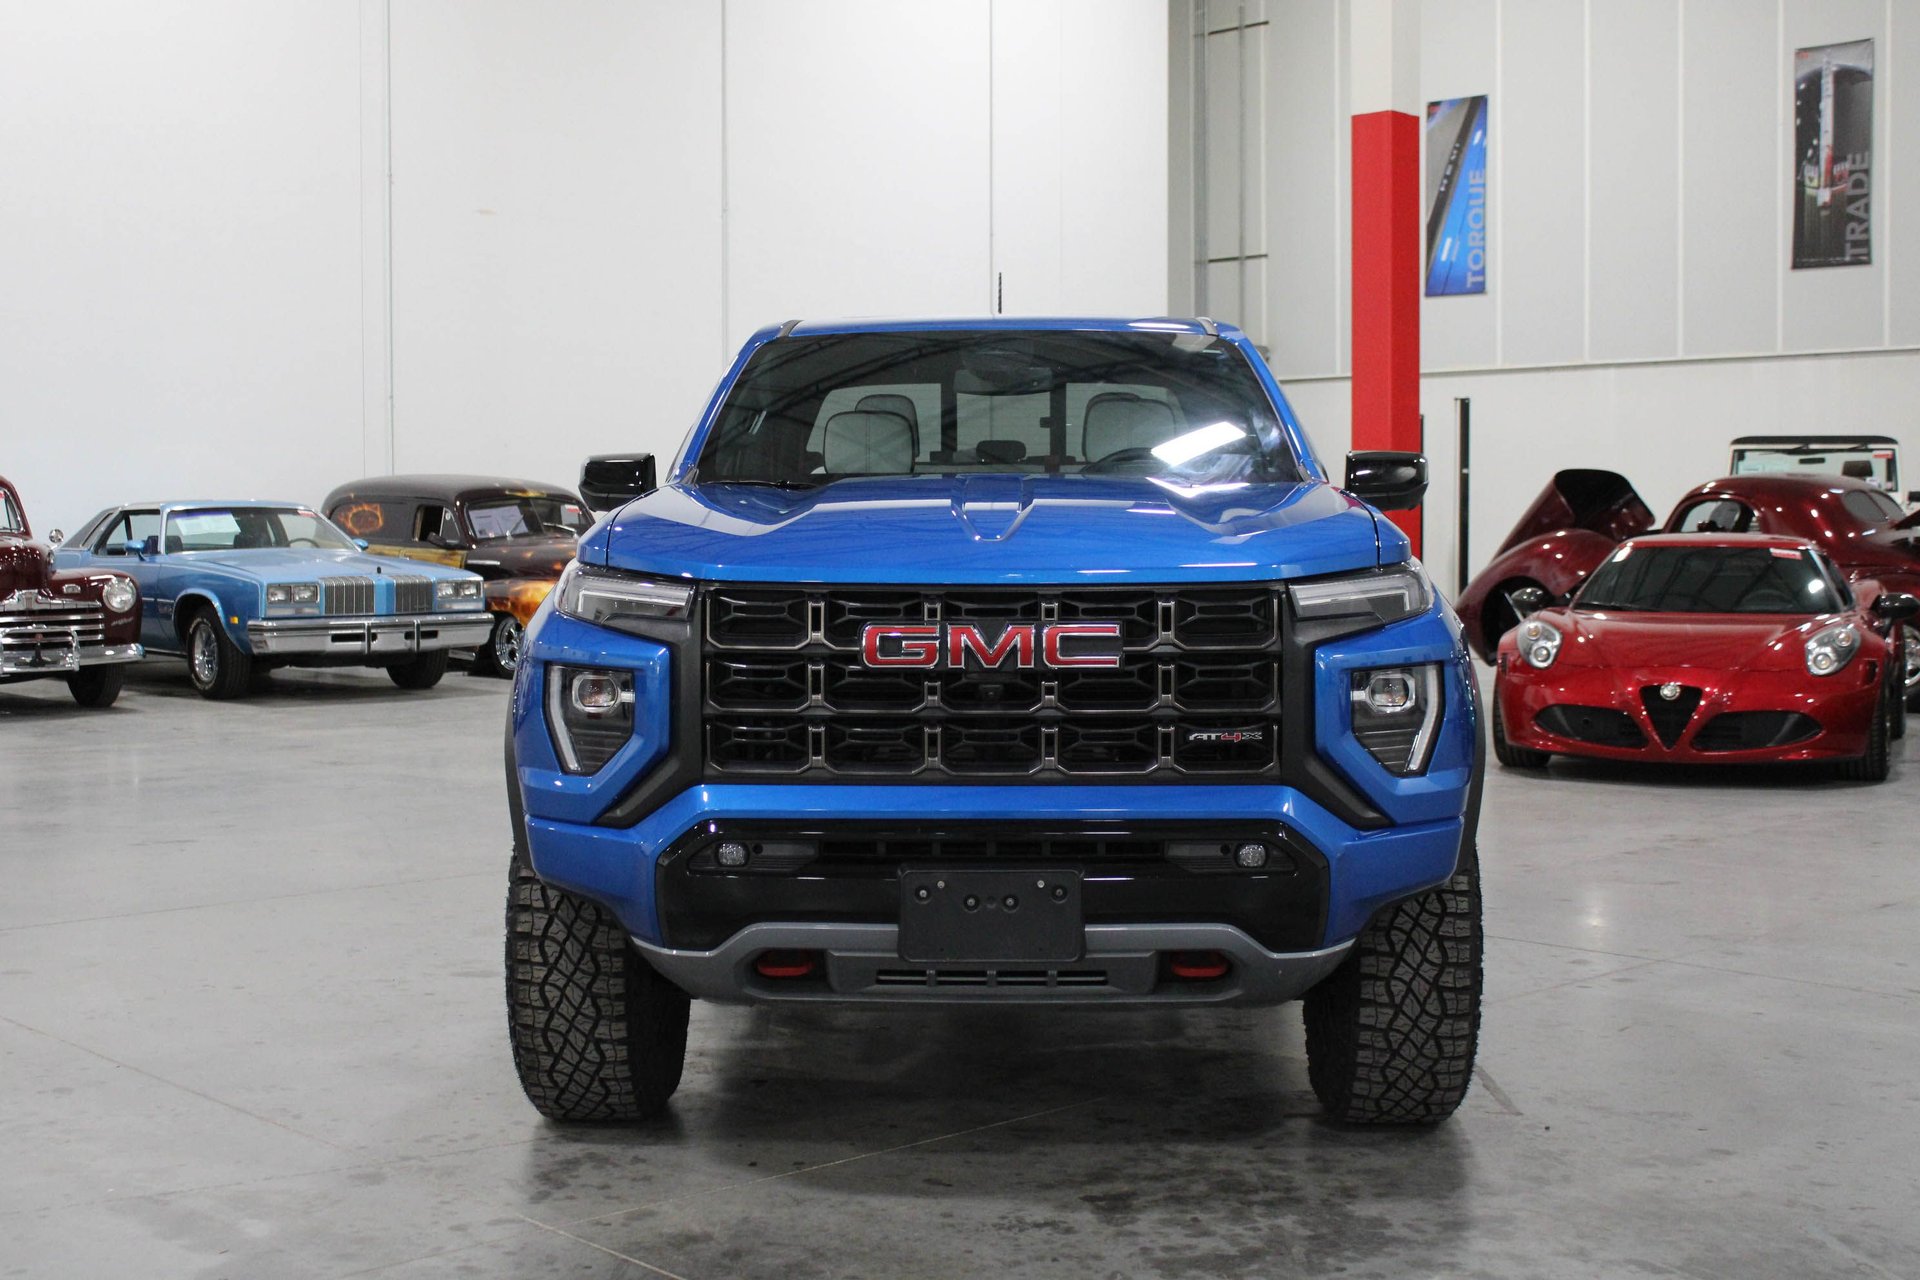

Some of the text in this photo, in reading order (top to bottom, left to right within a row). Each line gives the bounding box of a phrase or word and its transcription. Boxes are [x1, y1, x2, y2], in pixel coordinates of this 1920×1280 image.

[1467, 169, 1485, 288] TORQUE
[1845, 152, 1869, 261] TRADE
[862, 623, 1121, 669] GMC
[1189, 732, 1262, 742] AT4X
